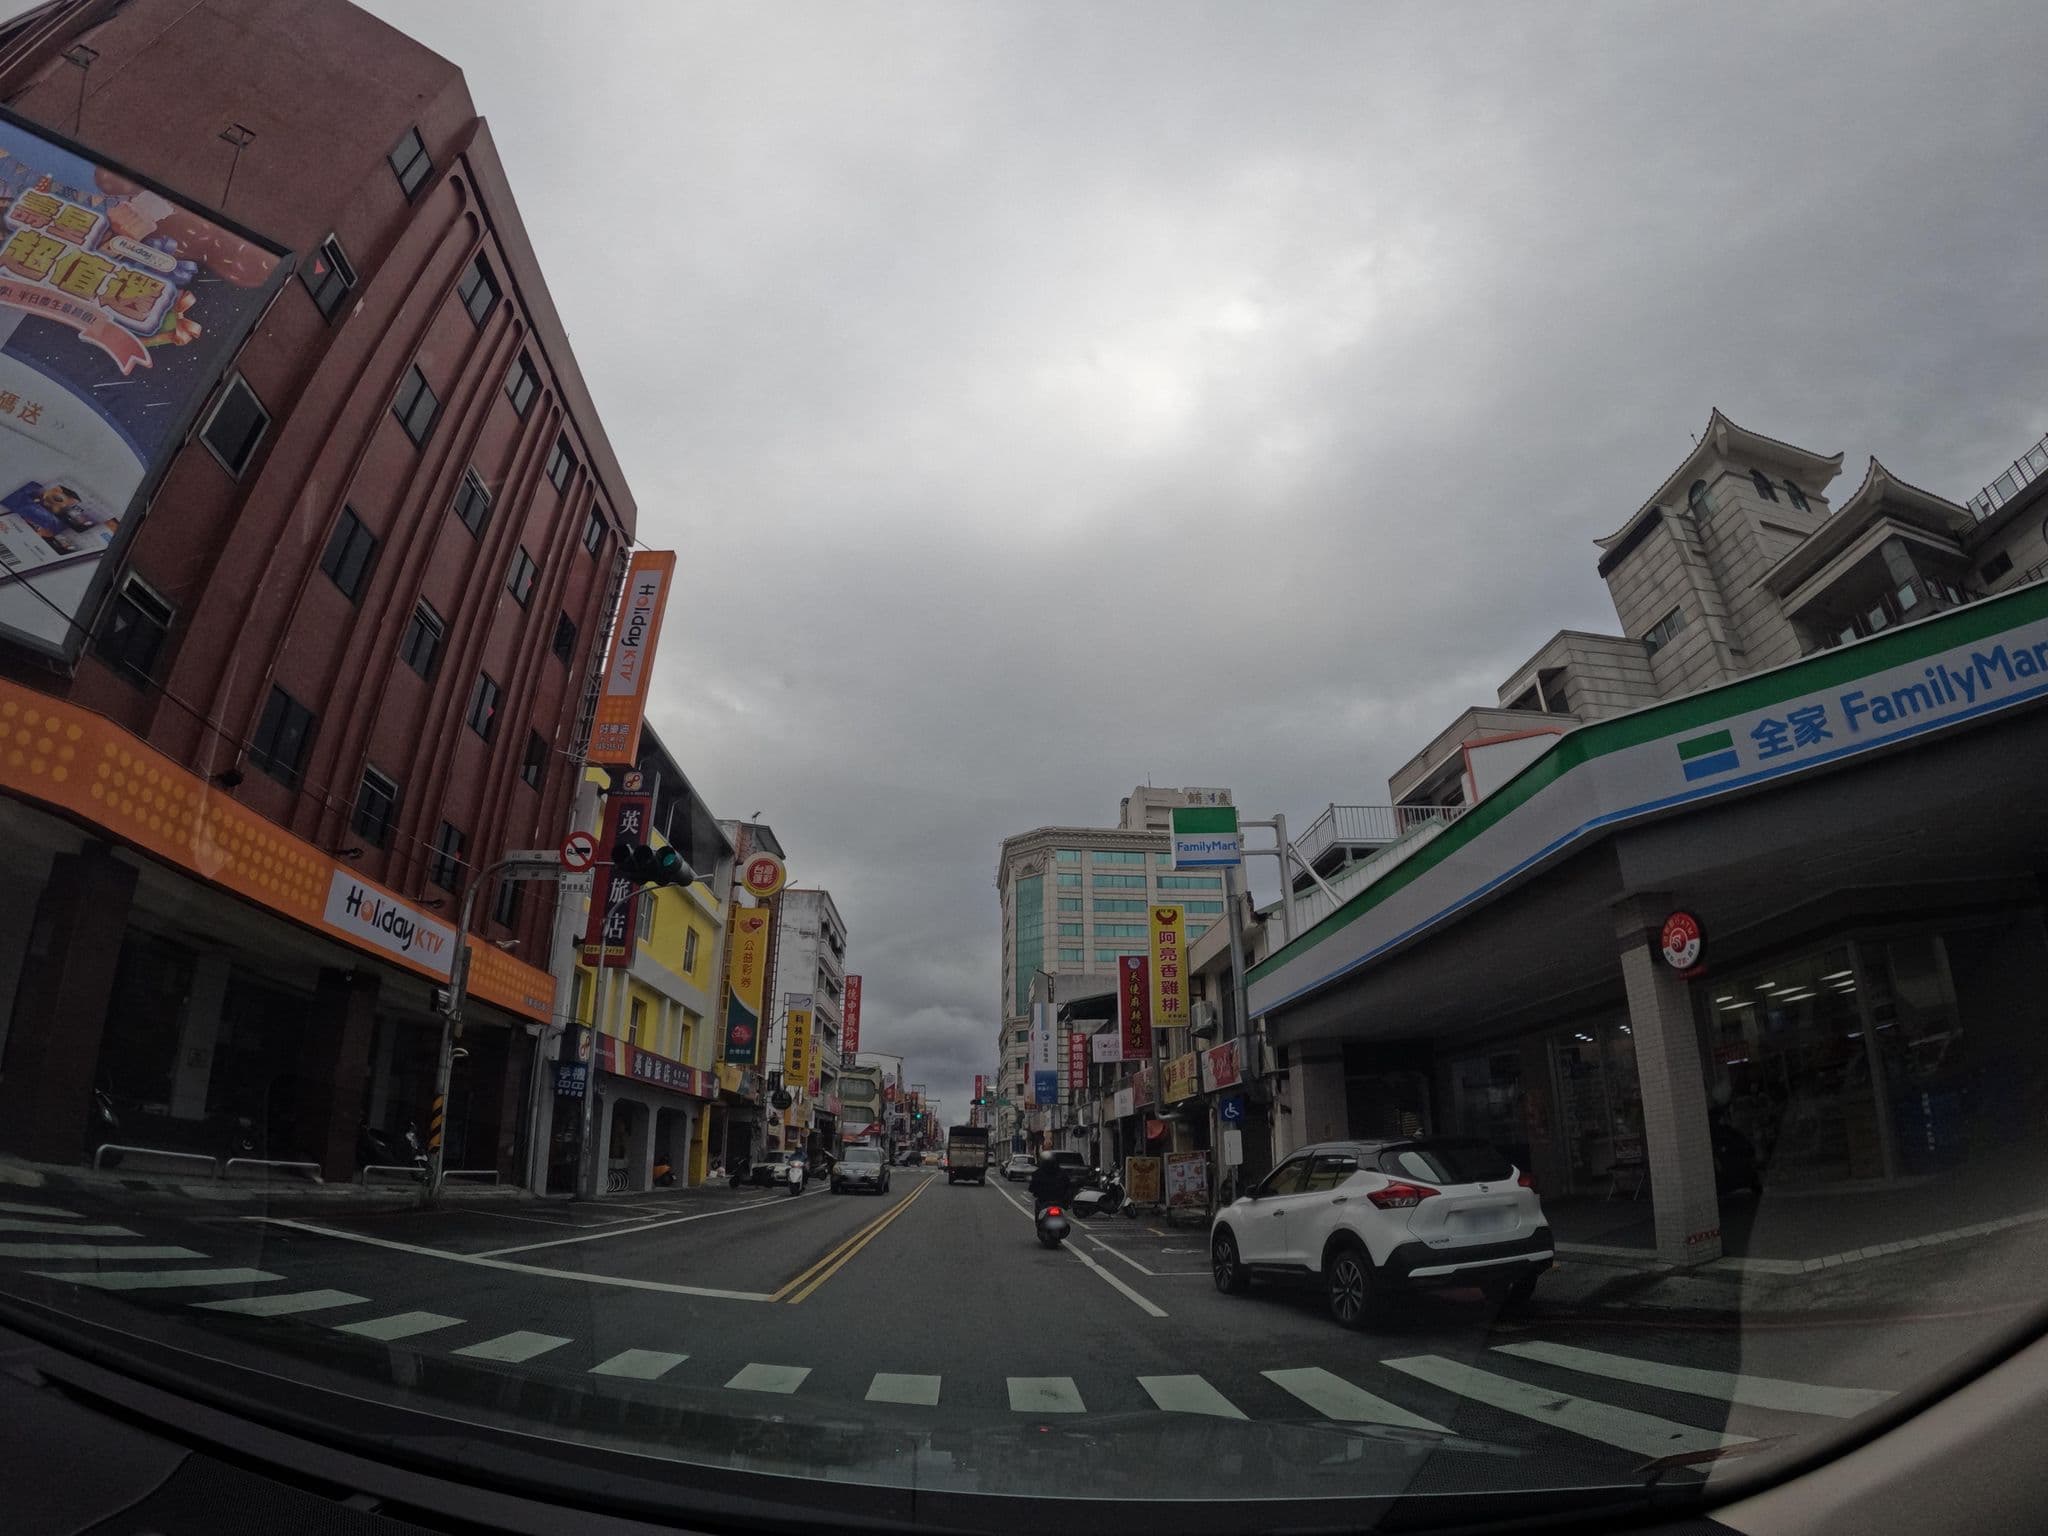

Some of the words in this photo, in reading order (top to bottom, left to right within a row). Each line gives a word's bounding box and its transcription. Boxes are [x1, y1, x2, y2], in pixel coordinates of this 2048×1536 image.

[621, 583, 656, 648] Holiday
[618, 650, 636, 682] KTV
[1750, 703, 1833, 760] 全家
[606, 809, 642, 941] 英旅店
[1177, 841, 1238, 853] FamilyMart
[346, 886, 415, 951] Holiday
[415, 928, 444, 955] KTV
